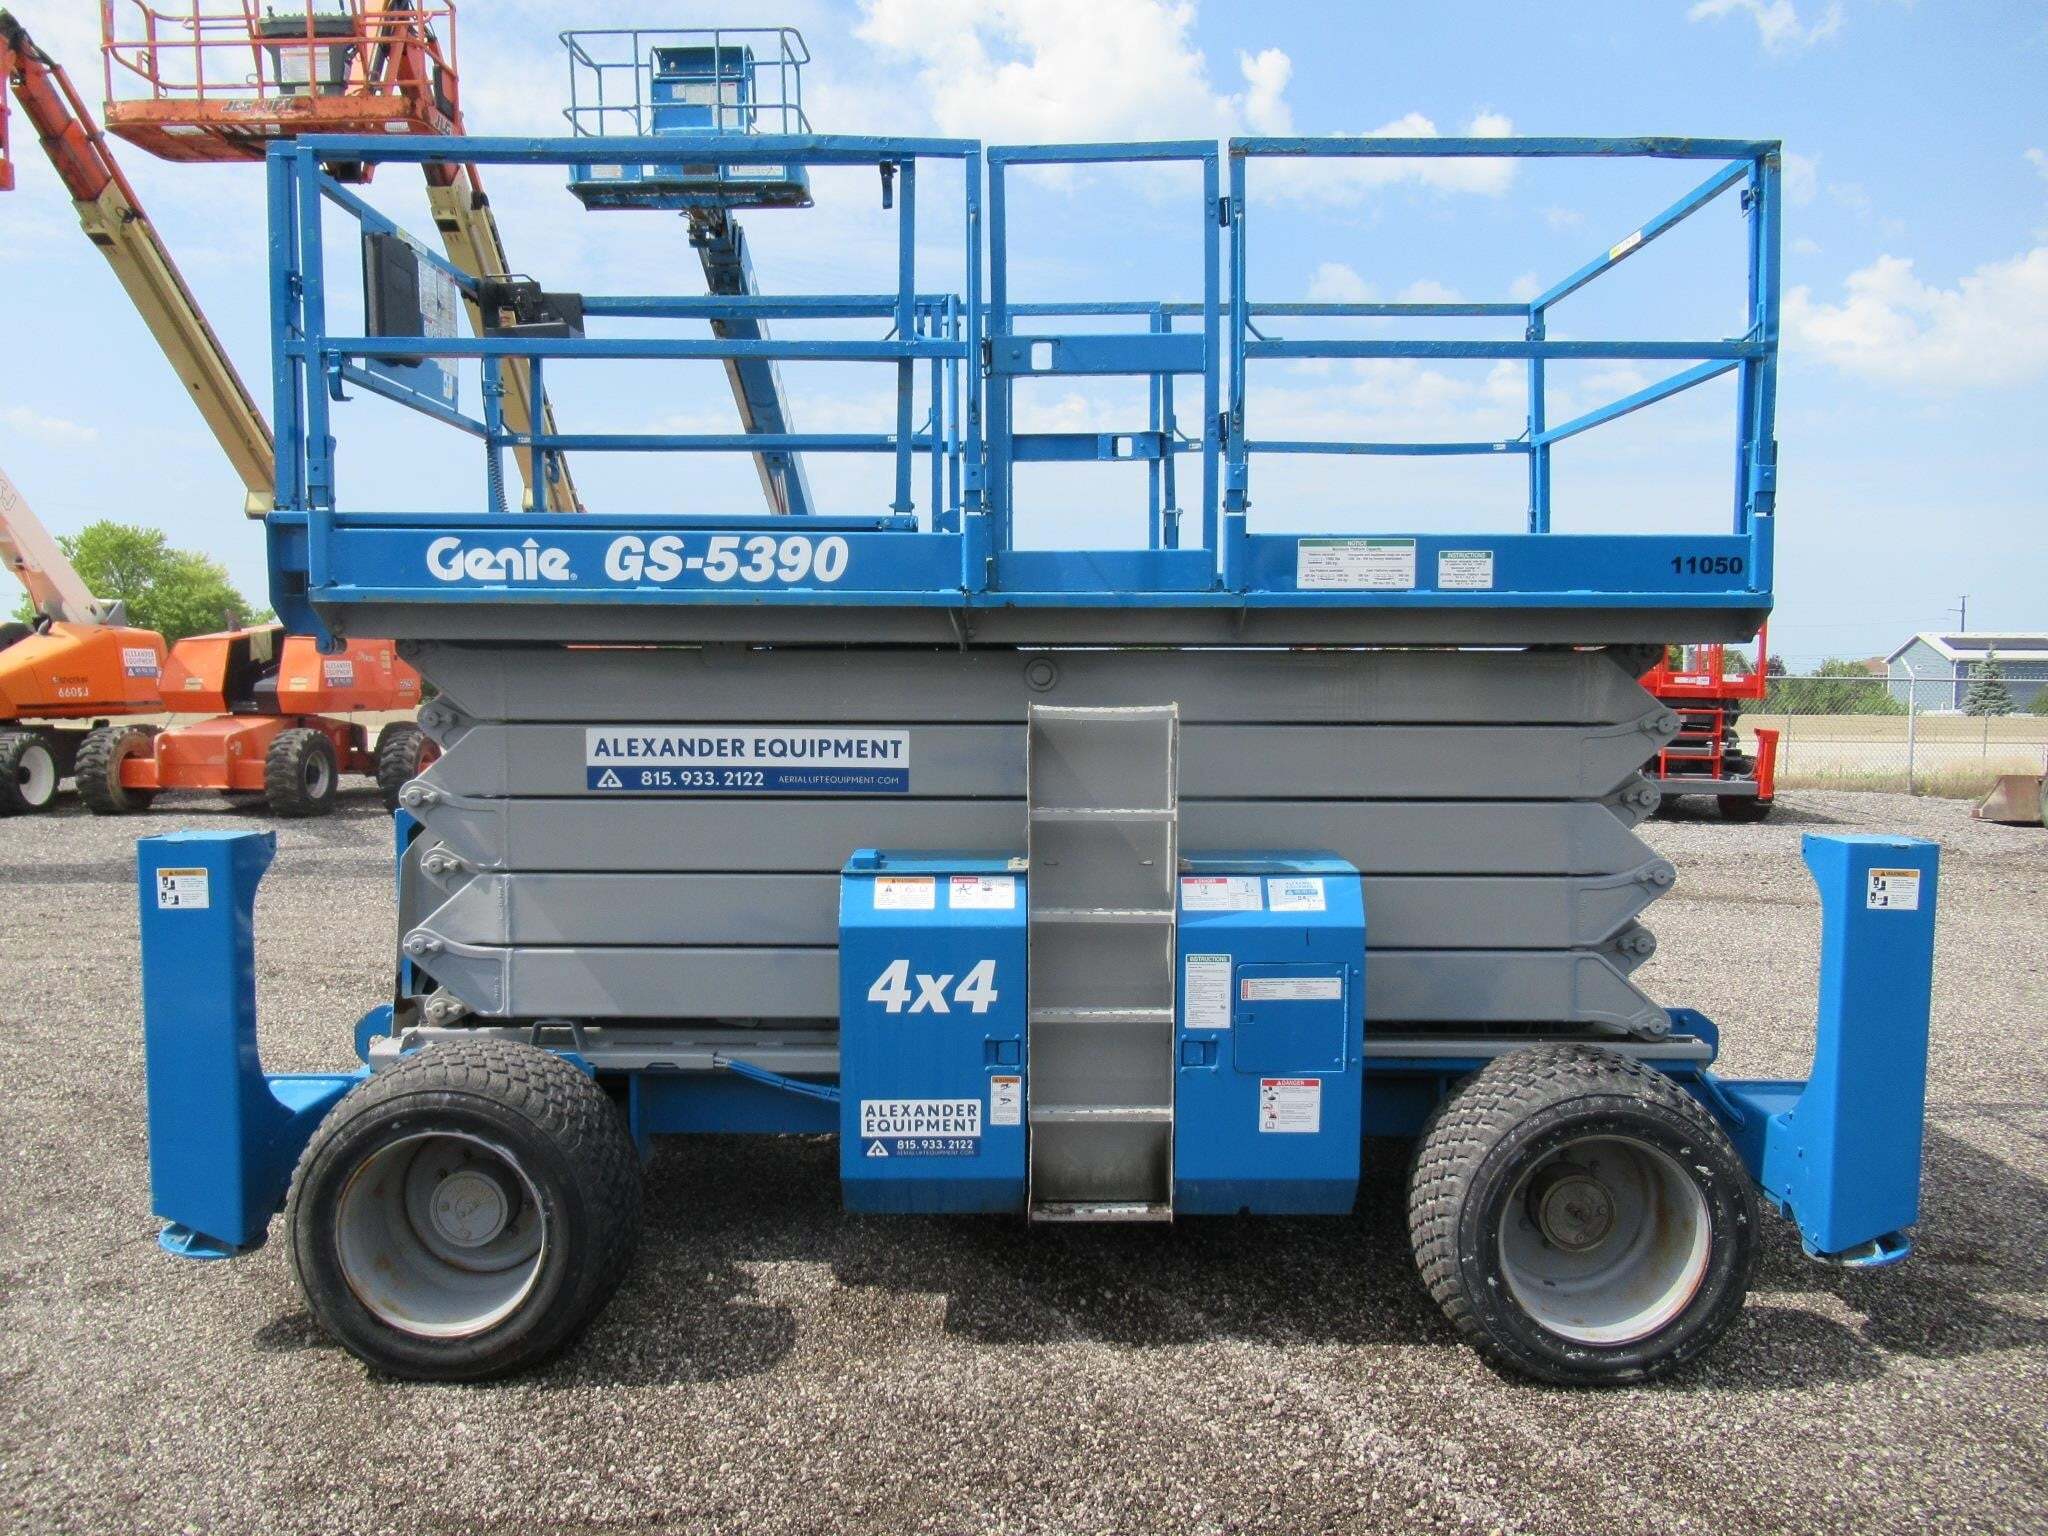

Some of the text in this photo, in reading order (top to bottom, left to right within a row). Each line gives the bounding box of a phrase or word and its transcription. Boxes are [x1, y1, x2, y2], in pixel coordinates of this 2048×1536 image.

[426, 535, 849, 582] Genie GS-5390
[1670, 556, 1743, 575] 11050
[594, 737, 902, 759] ALEXANDER EQUIPMENT
[867, 959, 998, 1013] 4x4
[865, 1104, 977, 1117] ALEXANDER
[866, 1119, 977, 1132] EQUIPMENT
